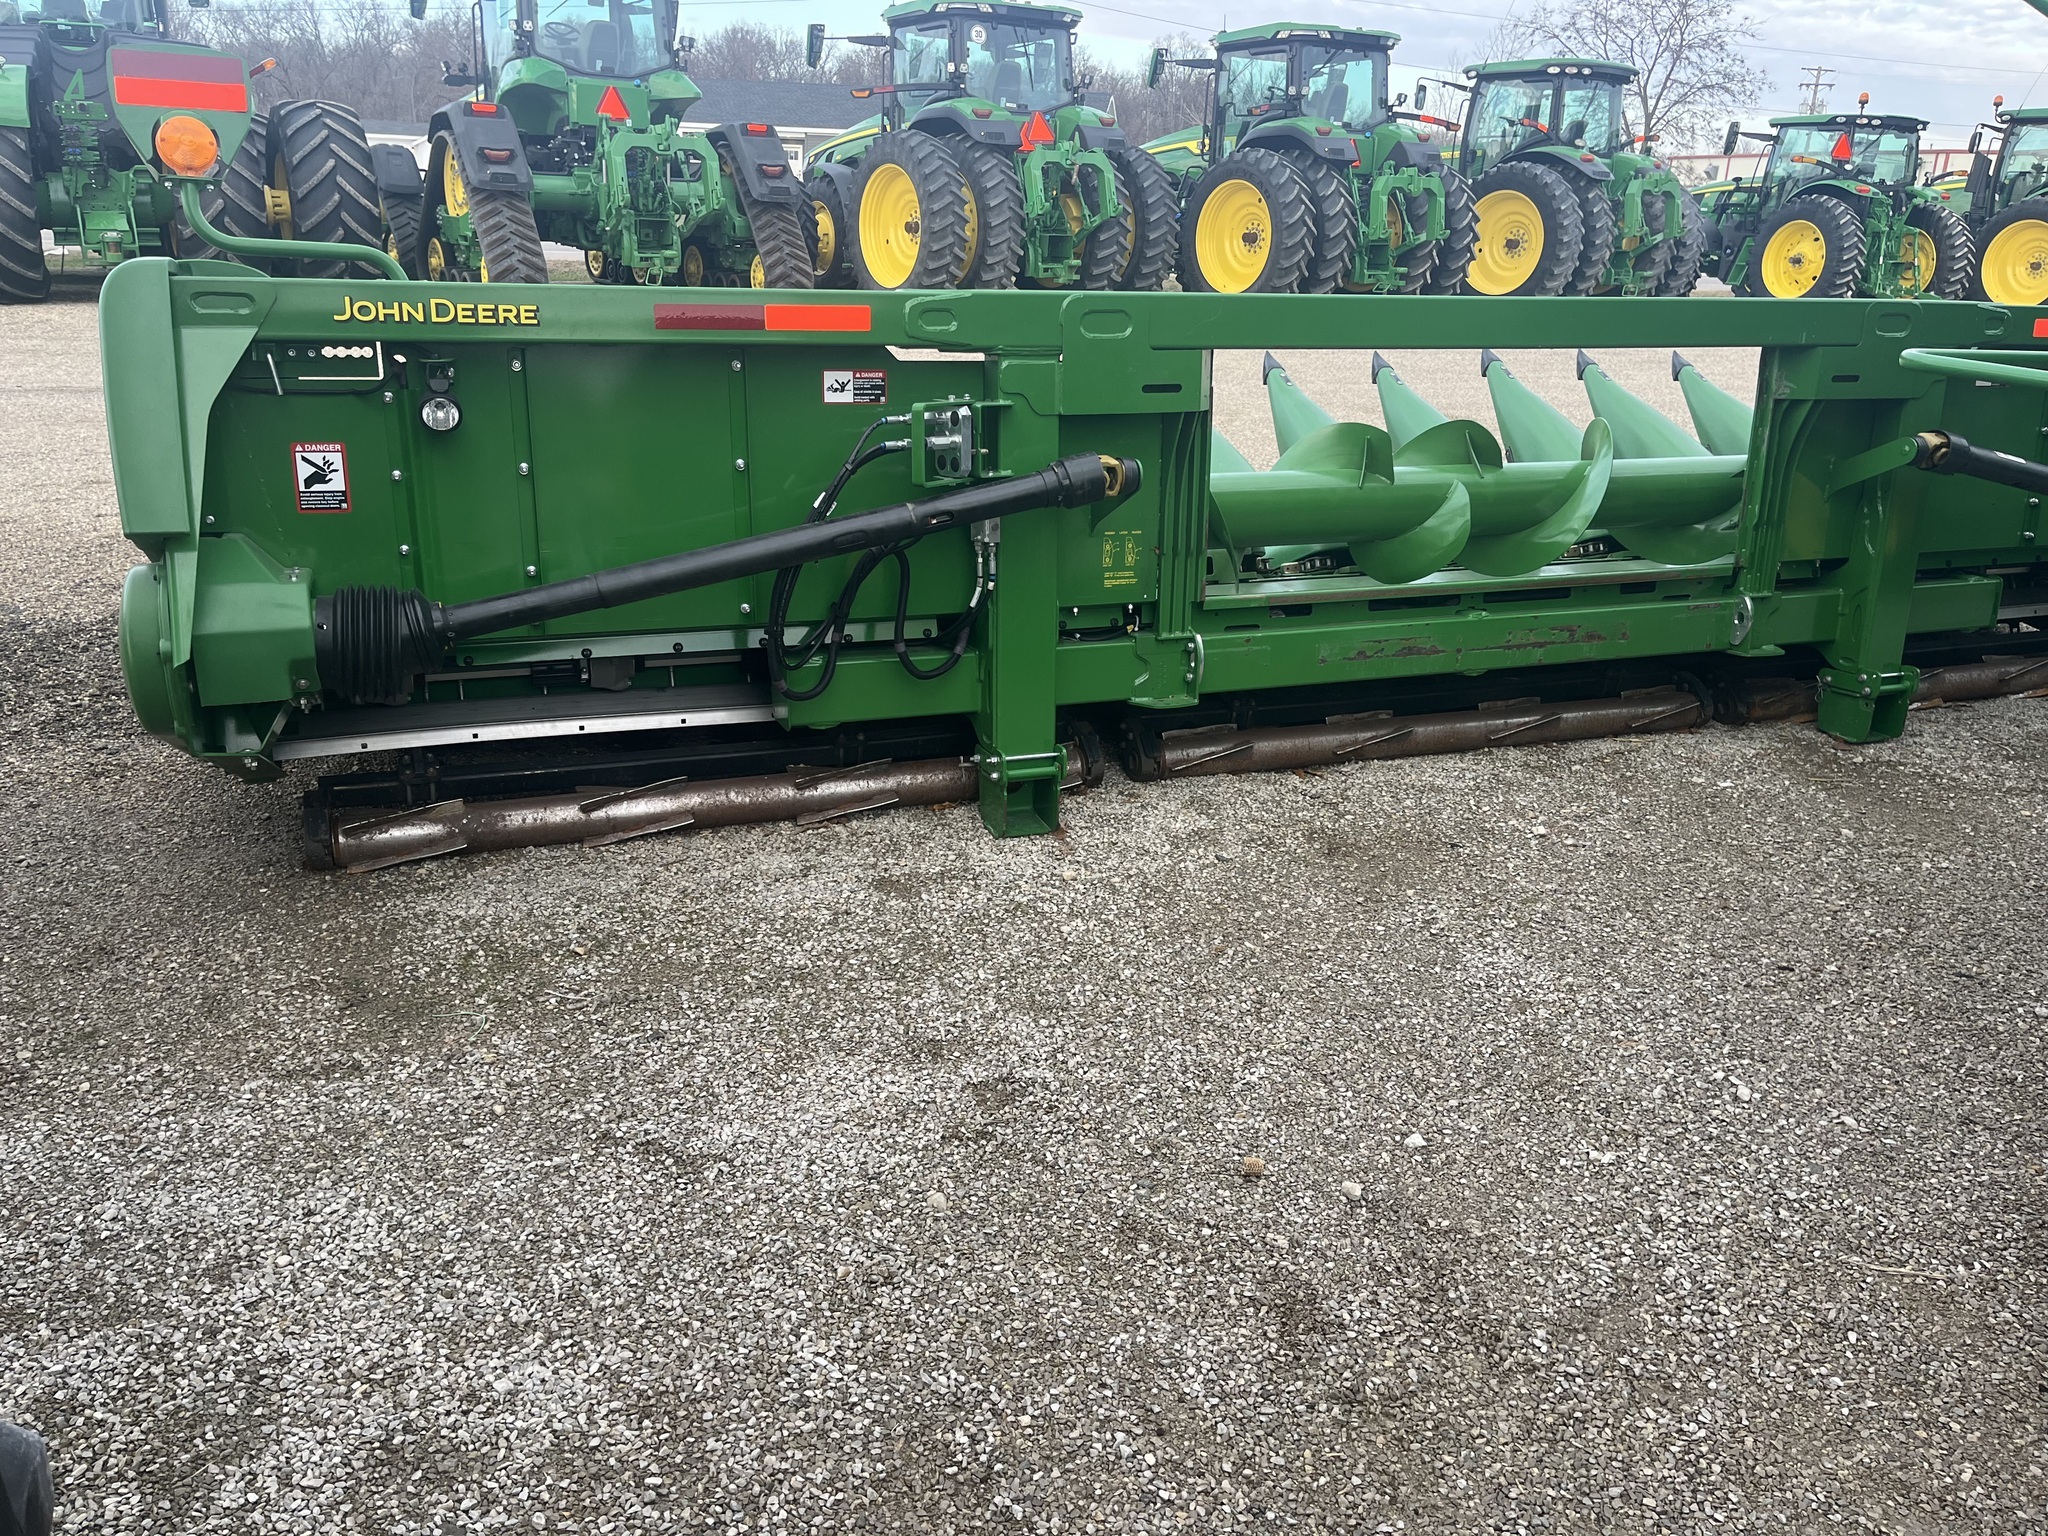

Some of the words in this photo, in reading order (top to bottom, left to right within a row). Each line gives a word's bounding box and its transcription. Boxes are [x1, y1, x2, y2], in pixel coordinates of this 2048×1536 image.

[974, 29, 983, 39] 30
[333, 296, 426, 323] JOHN
[429, 298, 540, 325] DEERE
